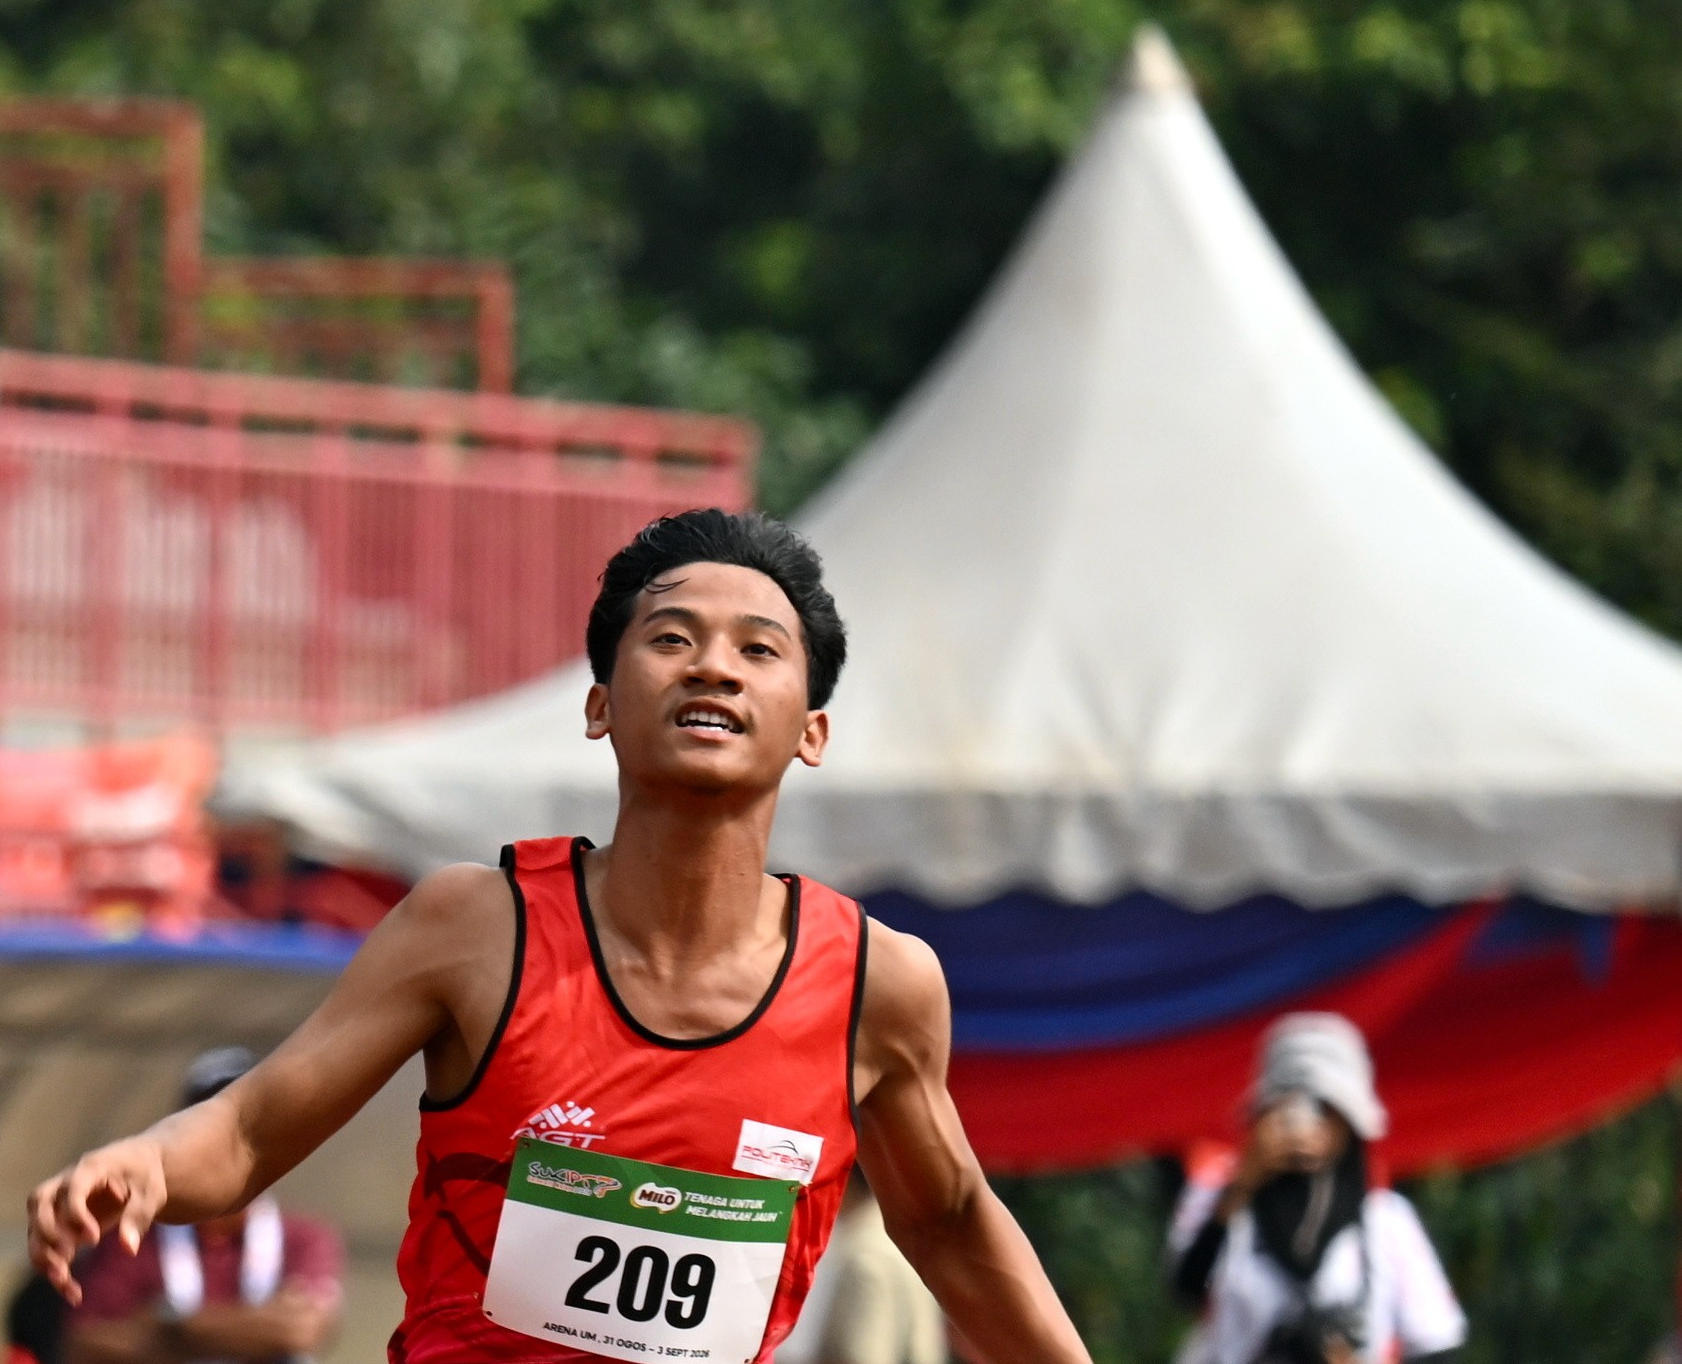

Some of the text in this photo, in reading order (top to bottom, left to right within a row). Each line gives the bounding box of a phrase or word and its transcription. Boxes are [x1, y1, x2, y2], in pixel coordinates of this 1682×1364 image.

[638, 1189, 676, 1206] MILO
[684, 1192, 765, 1209] TENAGA UNTUK
[564, 1235, 716, 1329] 209
[543, 1322, 578, 1338] ARENA
[602, 1335, 614, 1345] 31
[616, 1338, 646, 1352] OGOS
[657, 1345, 663, 1355] 3
[665, 1347, 688, 1357] SEPT
[690, 1350, 709, 1358] 2026
